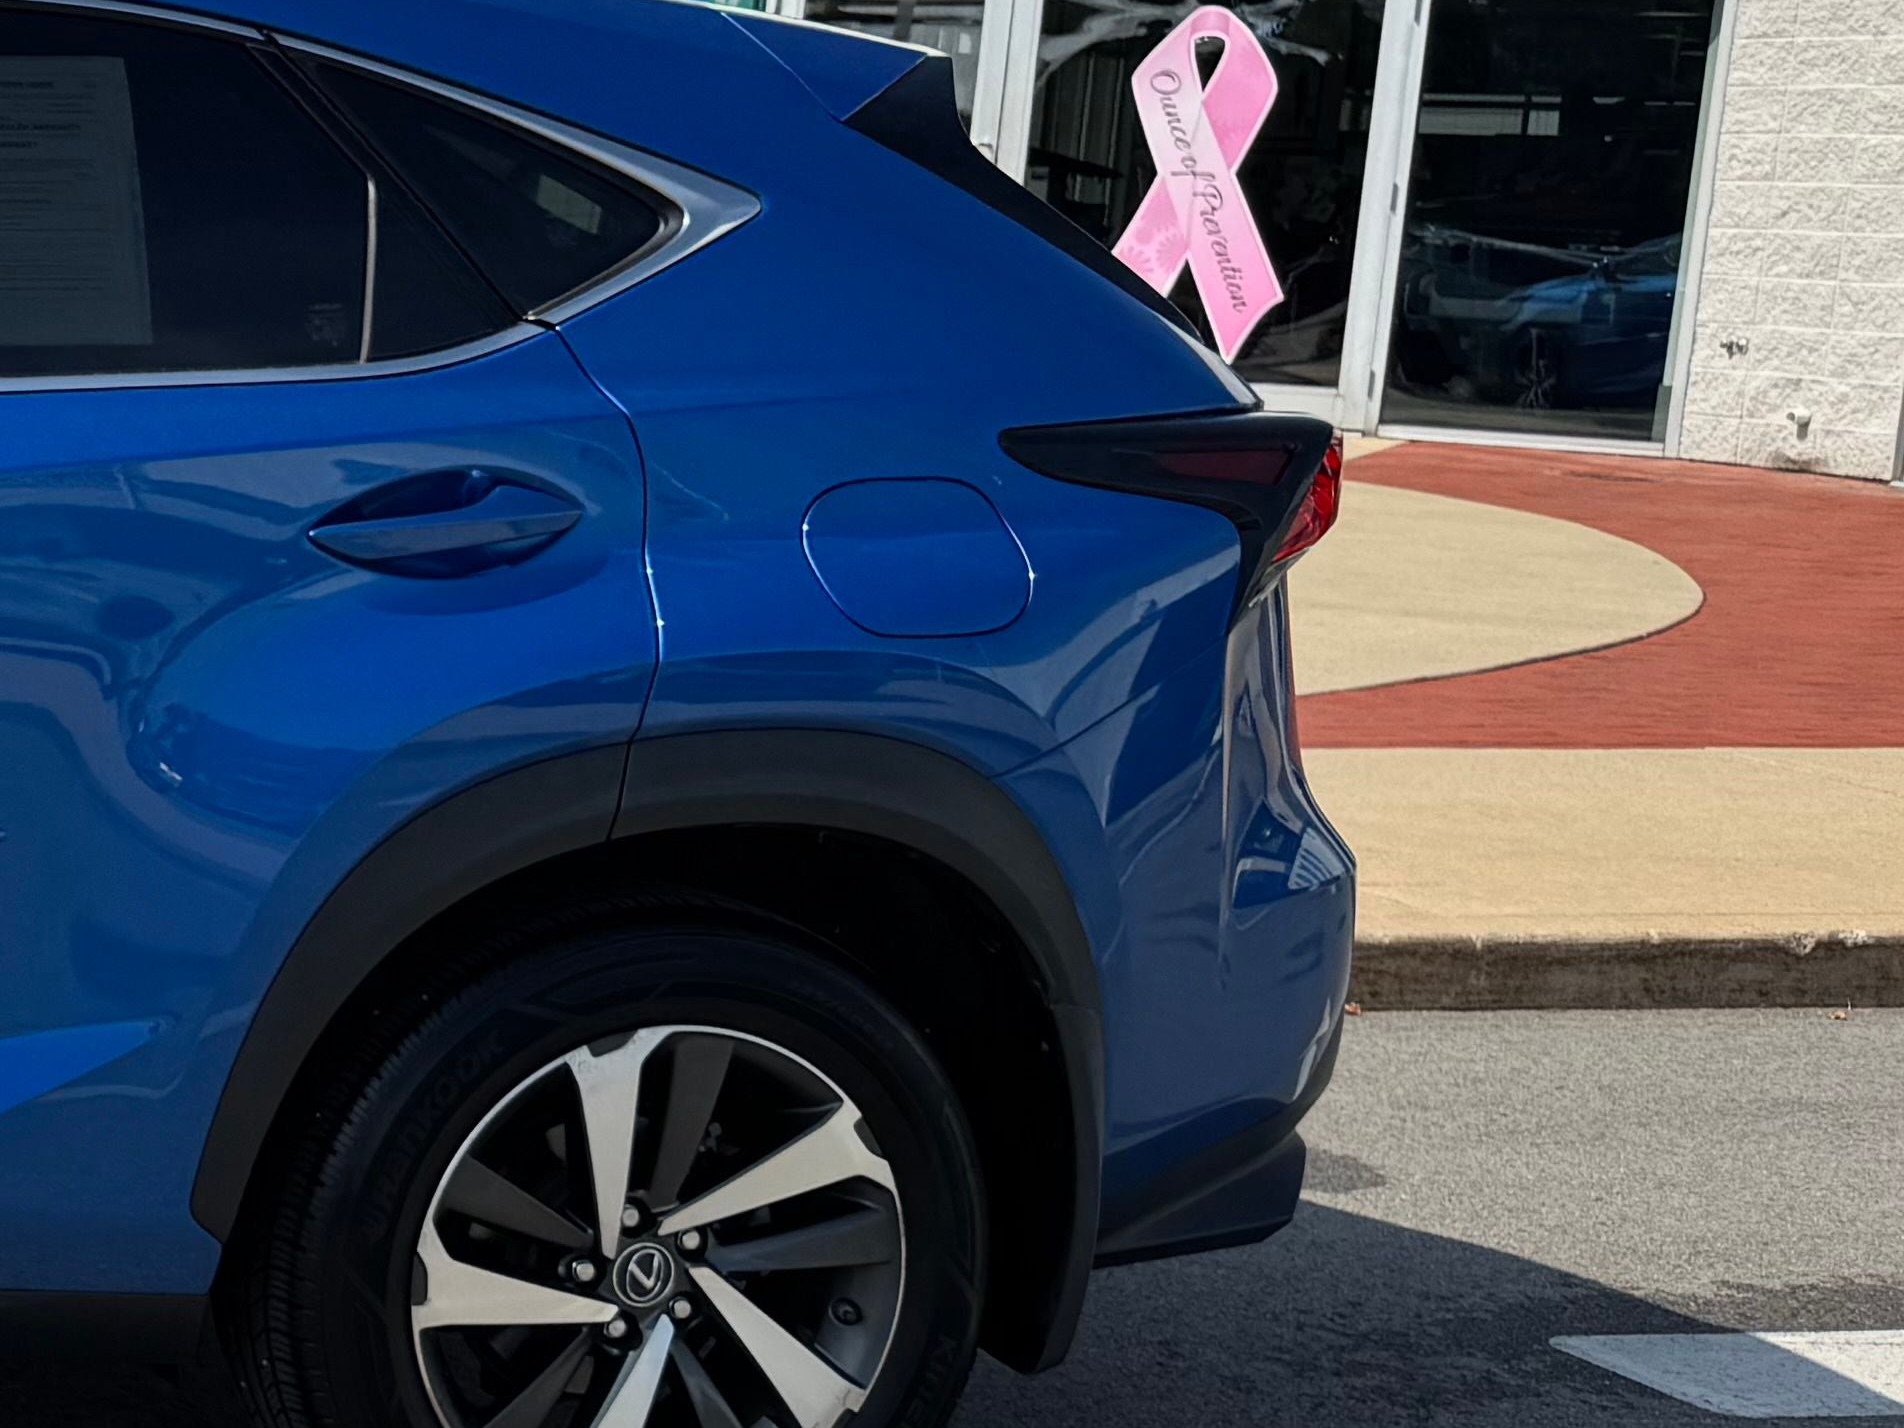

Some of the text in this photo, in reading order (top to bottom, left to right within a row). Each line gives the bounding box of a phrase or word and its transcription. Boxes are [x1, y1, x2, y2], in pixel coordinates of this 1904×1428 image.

[1149, 69, 1248, 314] Ounce of Prevention
